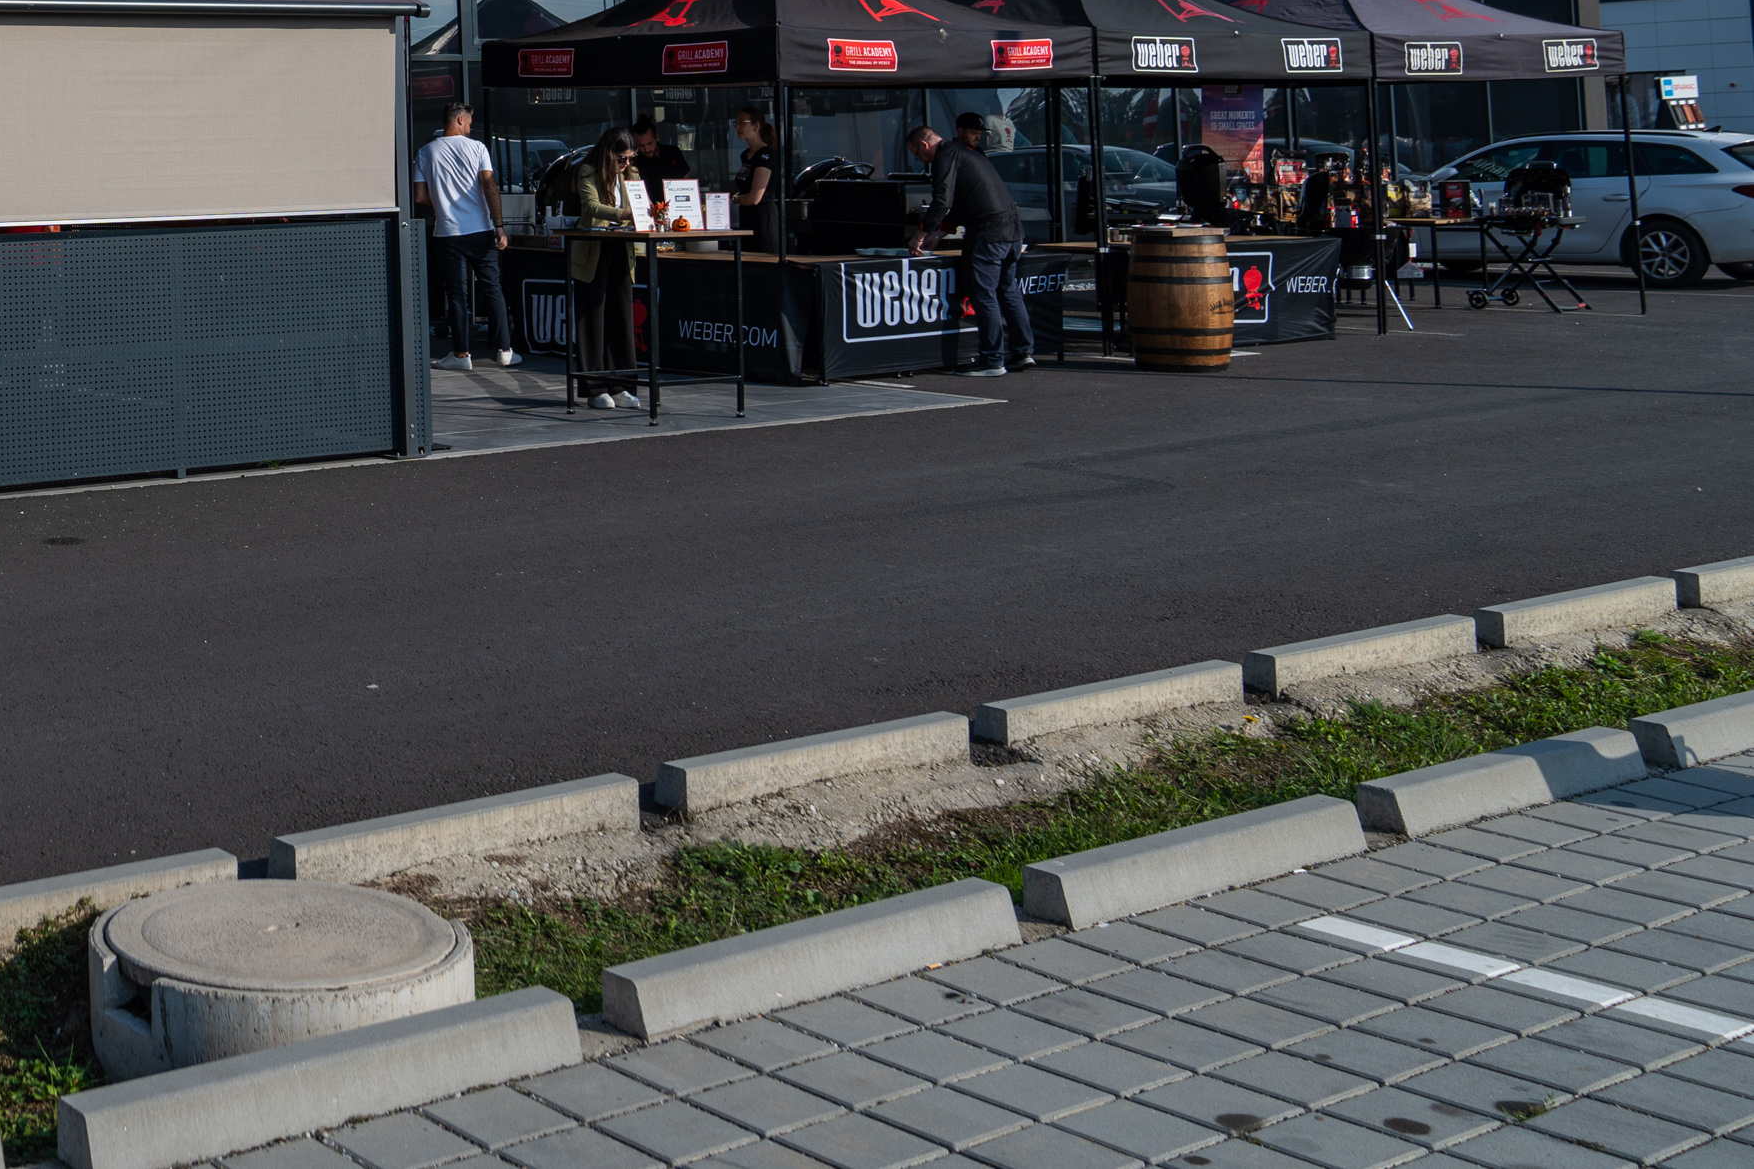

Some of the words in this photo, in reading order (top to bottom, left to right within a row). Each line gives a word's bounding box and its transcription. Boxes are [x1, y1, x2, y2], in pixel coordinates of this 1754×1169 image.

[1136, 38, 1180, 68] weber
[1287, 39, 1327, 68] weber
[1409, 42, 1448, 70] weber
[1547, 40, 1584, 68] weber
[853, 258, 956, 328] weber
